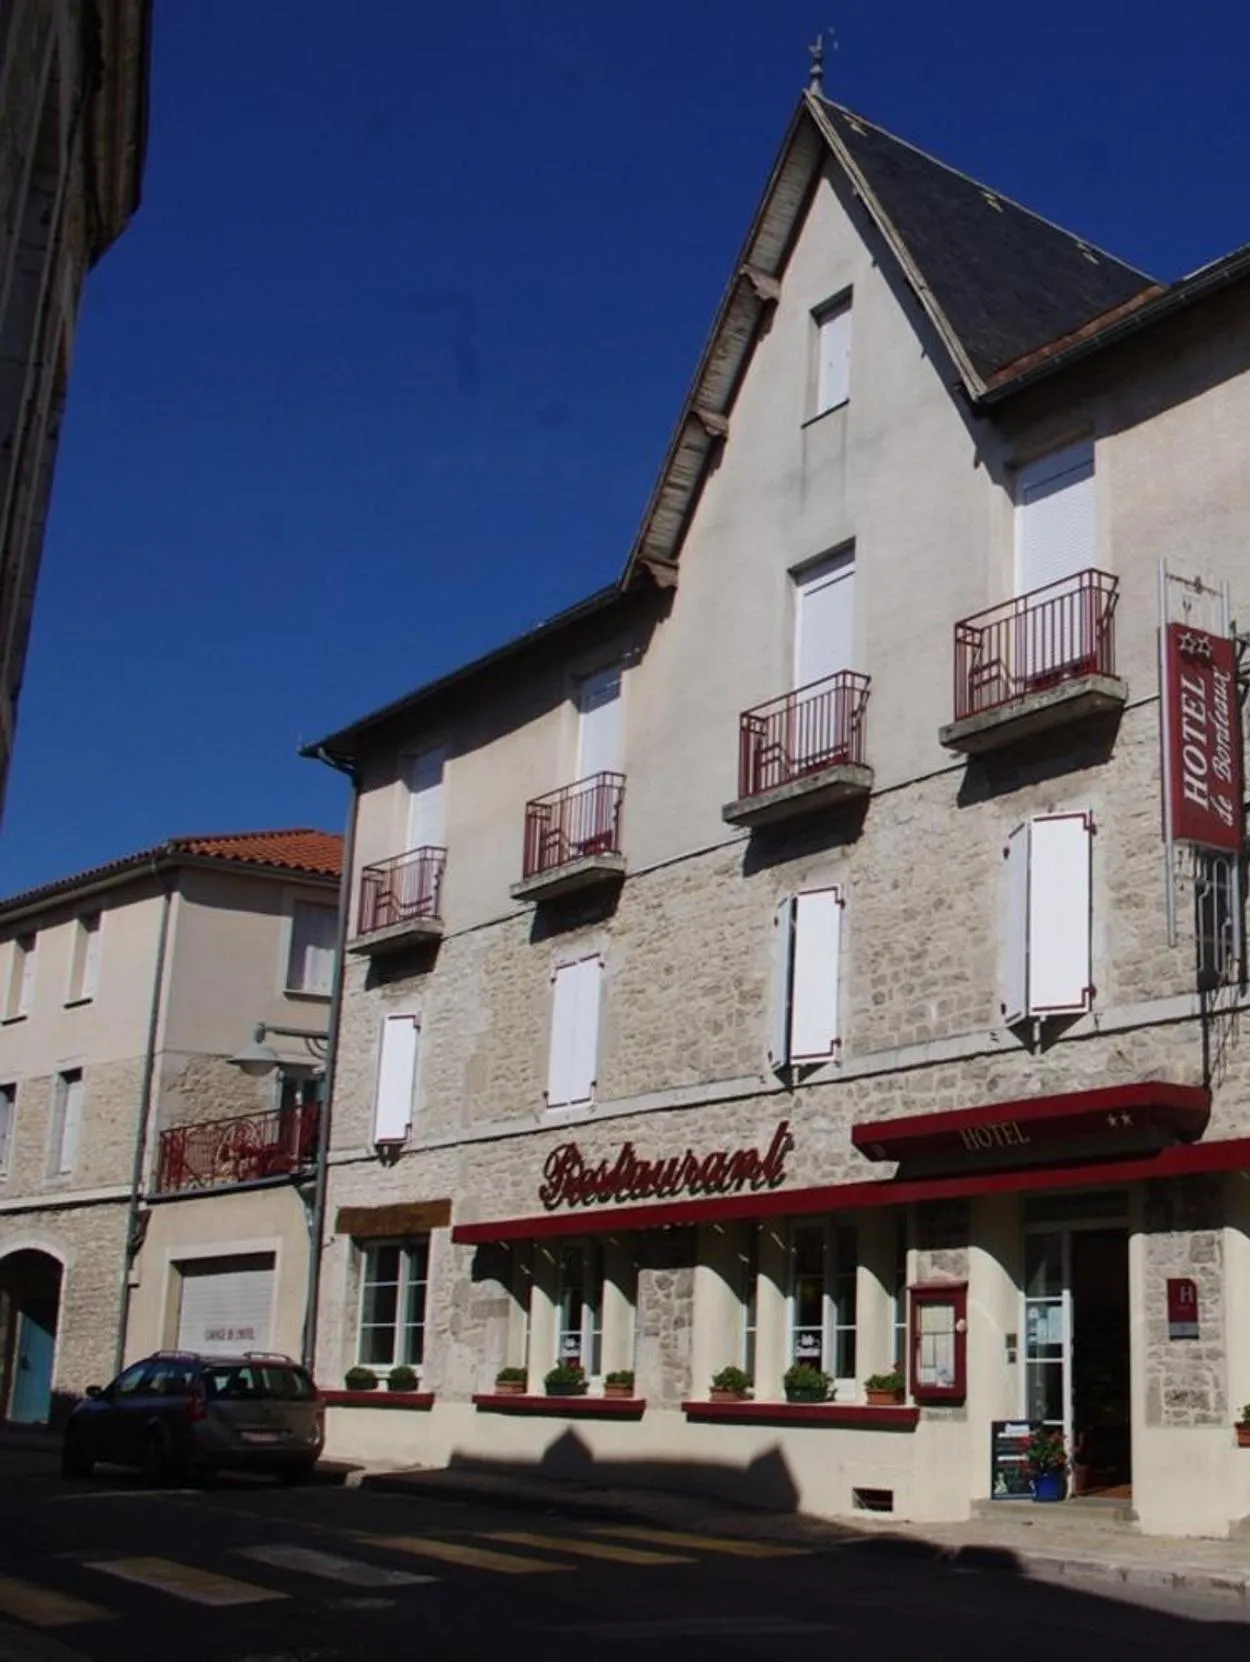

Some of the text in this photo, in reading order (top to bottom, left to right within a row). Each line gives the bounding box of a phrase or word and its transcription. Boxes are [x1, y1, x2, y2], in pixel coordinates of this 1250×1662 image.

[1181, 674, 1209, 811] HOTEL
[1208, 665, 1232, 784] Bordeaux
[538, 1119, 795, 1206] Restaurant
[960, 1119, 1030, 1150] HOTEL
[1180, 1284, 1195, 1304] H
